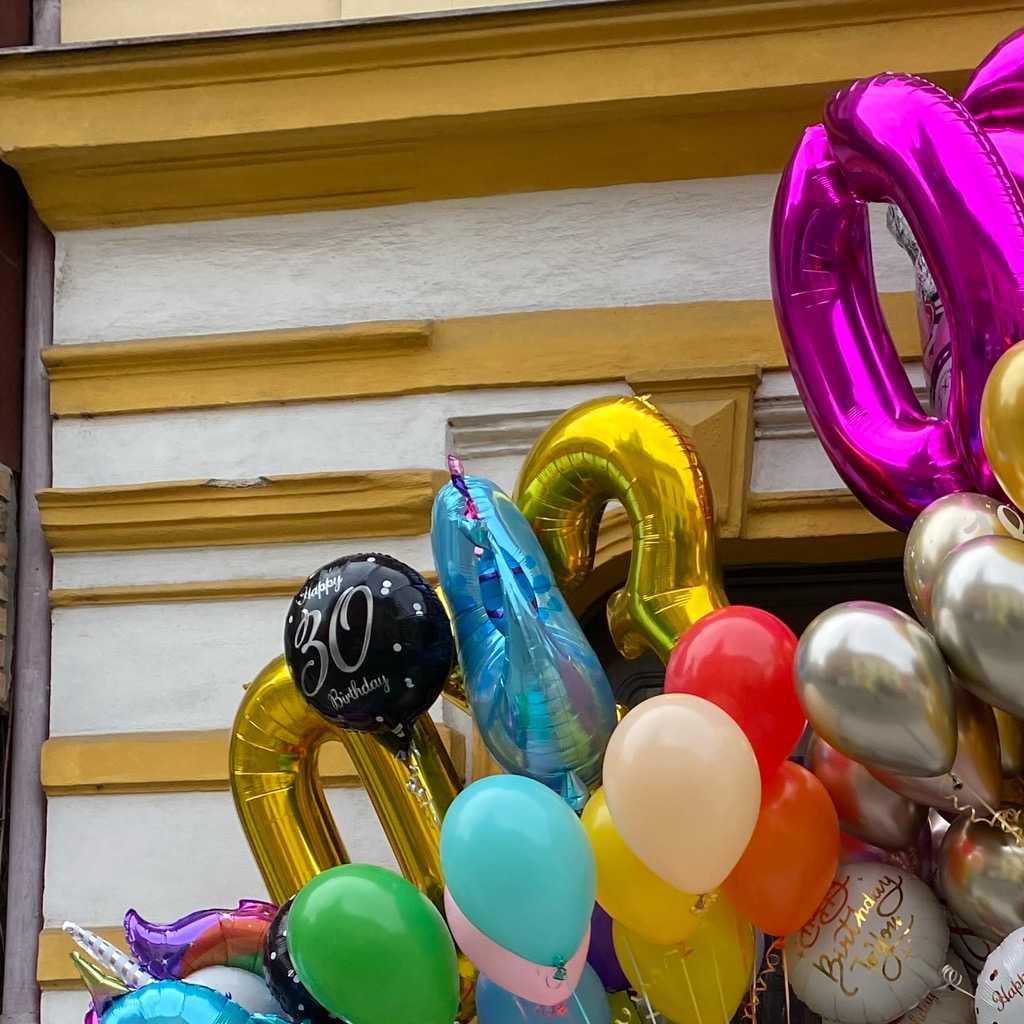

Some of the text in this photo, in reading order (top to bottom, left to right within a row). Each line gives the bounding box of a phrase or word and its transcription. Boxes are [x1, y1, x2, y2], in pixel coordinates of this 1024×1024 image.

[296, 574, 344, 606] Happy
[294, 584, 374, 698] 30
[327, 674, 390, 711] Birthday
[812, 874, 904, 997] Birthday
